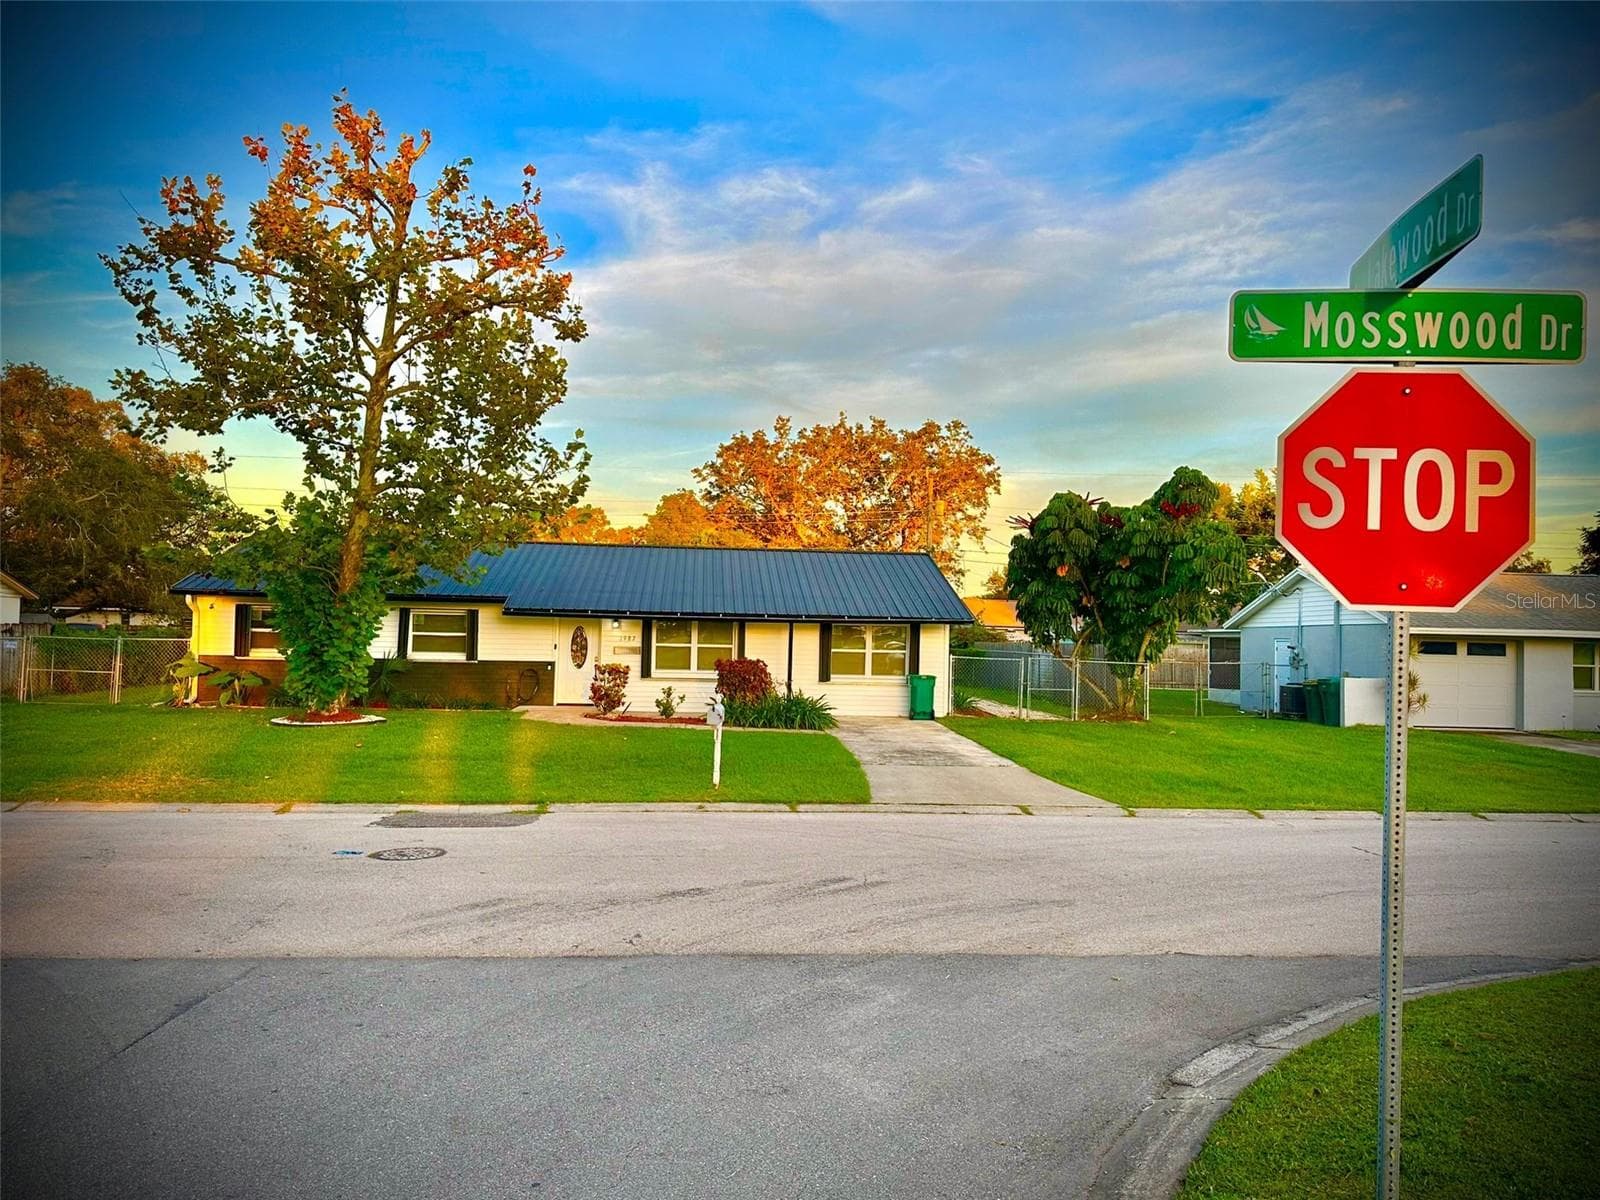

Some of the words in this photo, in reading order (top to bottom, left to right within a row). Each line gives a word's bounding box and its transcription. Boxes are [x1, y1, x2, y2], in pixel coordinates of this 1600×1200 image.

[1456, 192, 1475, 234] Dr
[1303, 301, 1522, 349] Mosswood
[1540, 314, 1573, 351] Dr
[1298, 446, 1515, 533] STOP
